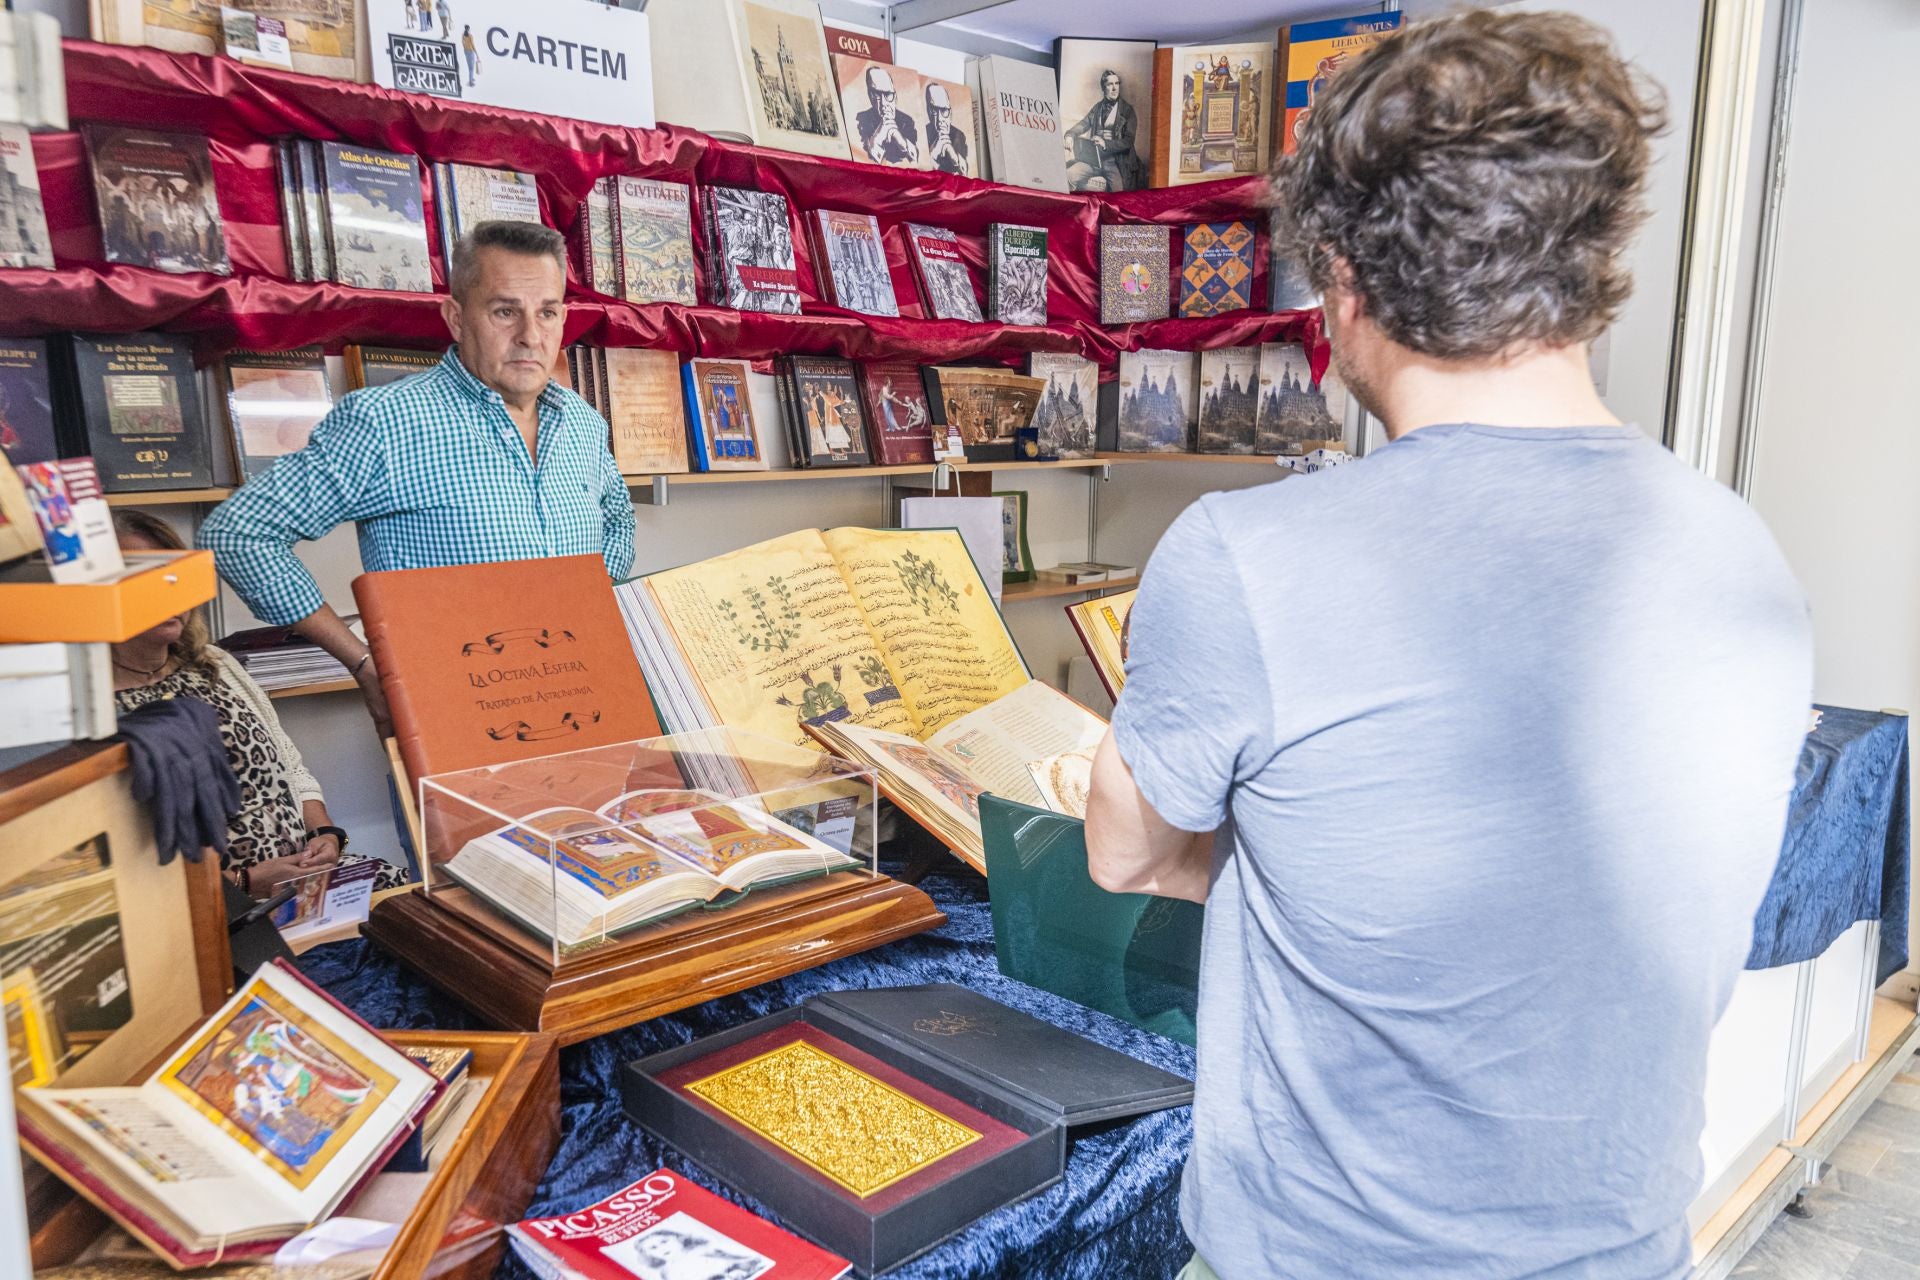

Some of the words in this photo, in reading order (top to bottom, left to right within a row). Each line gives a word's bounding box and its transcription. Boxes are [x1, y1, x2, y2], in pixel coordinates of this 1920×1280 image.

[394, 40, 454, 67] CARTEM
[487, 26, 627, 81] CARTEM
[838, 36, 870, 55] GOYA
[398, 70, 457, 94] CARTEM
[1000, 92, 1054, 116] BUFFON
[1003, 108, 1056, 133] PICASSO
[339, 151, 361, 163] Atlas
[362, 154, 374, 164] de
[375, 156, 411, 170] Ortelius
[624, 182, 686, 202] CIVITATES
[830, 221, 872, 241] Durero
[1004, 229, 1034, 239] ALBERTO
[1004, 237, 1032, 245] DURERO
[920, 238, 950, 251] DURERO
[1004, 244, 1040, 257] Apocalipsis
[741, 269, 783, 280] DURERO
[799, 366, 825, 374] PAPIRO
[837, 367, 851, 375] ANI
[468, 672, 489, 688] LA
[488, 665, 544, 683] OCTAVA
[542, 660, 589, 676] ESFERA
[475, 698, 521, 711] TRATADO
[521, 694, 535, 704] DE
[536, 685, 595, 703] ASTRONOMÍA
[528, 1175, 675, 1238] PICASSO
